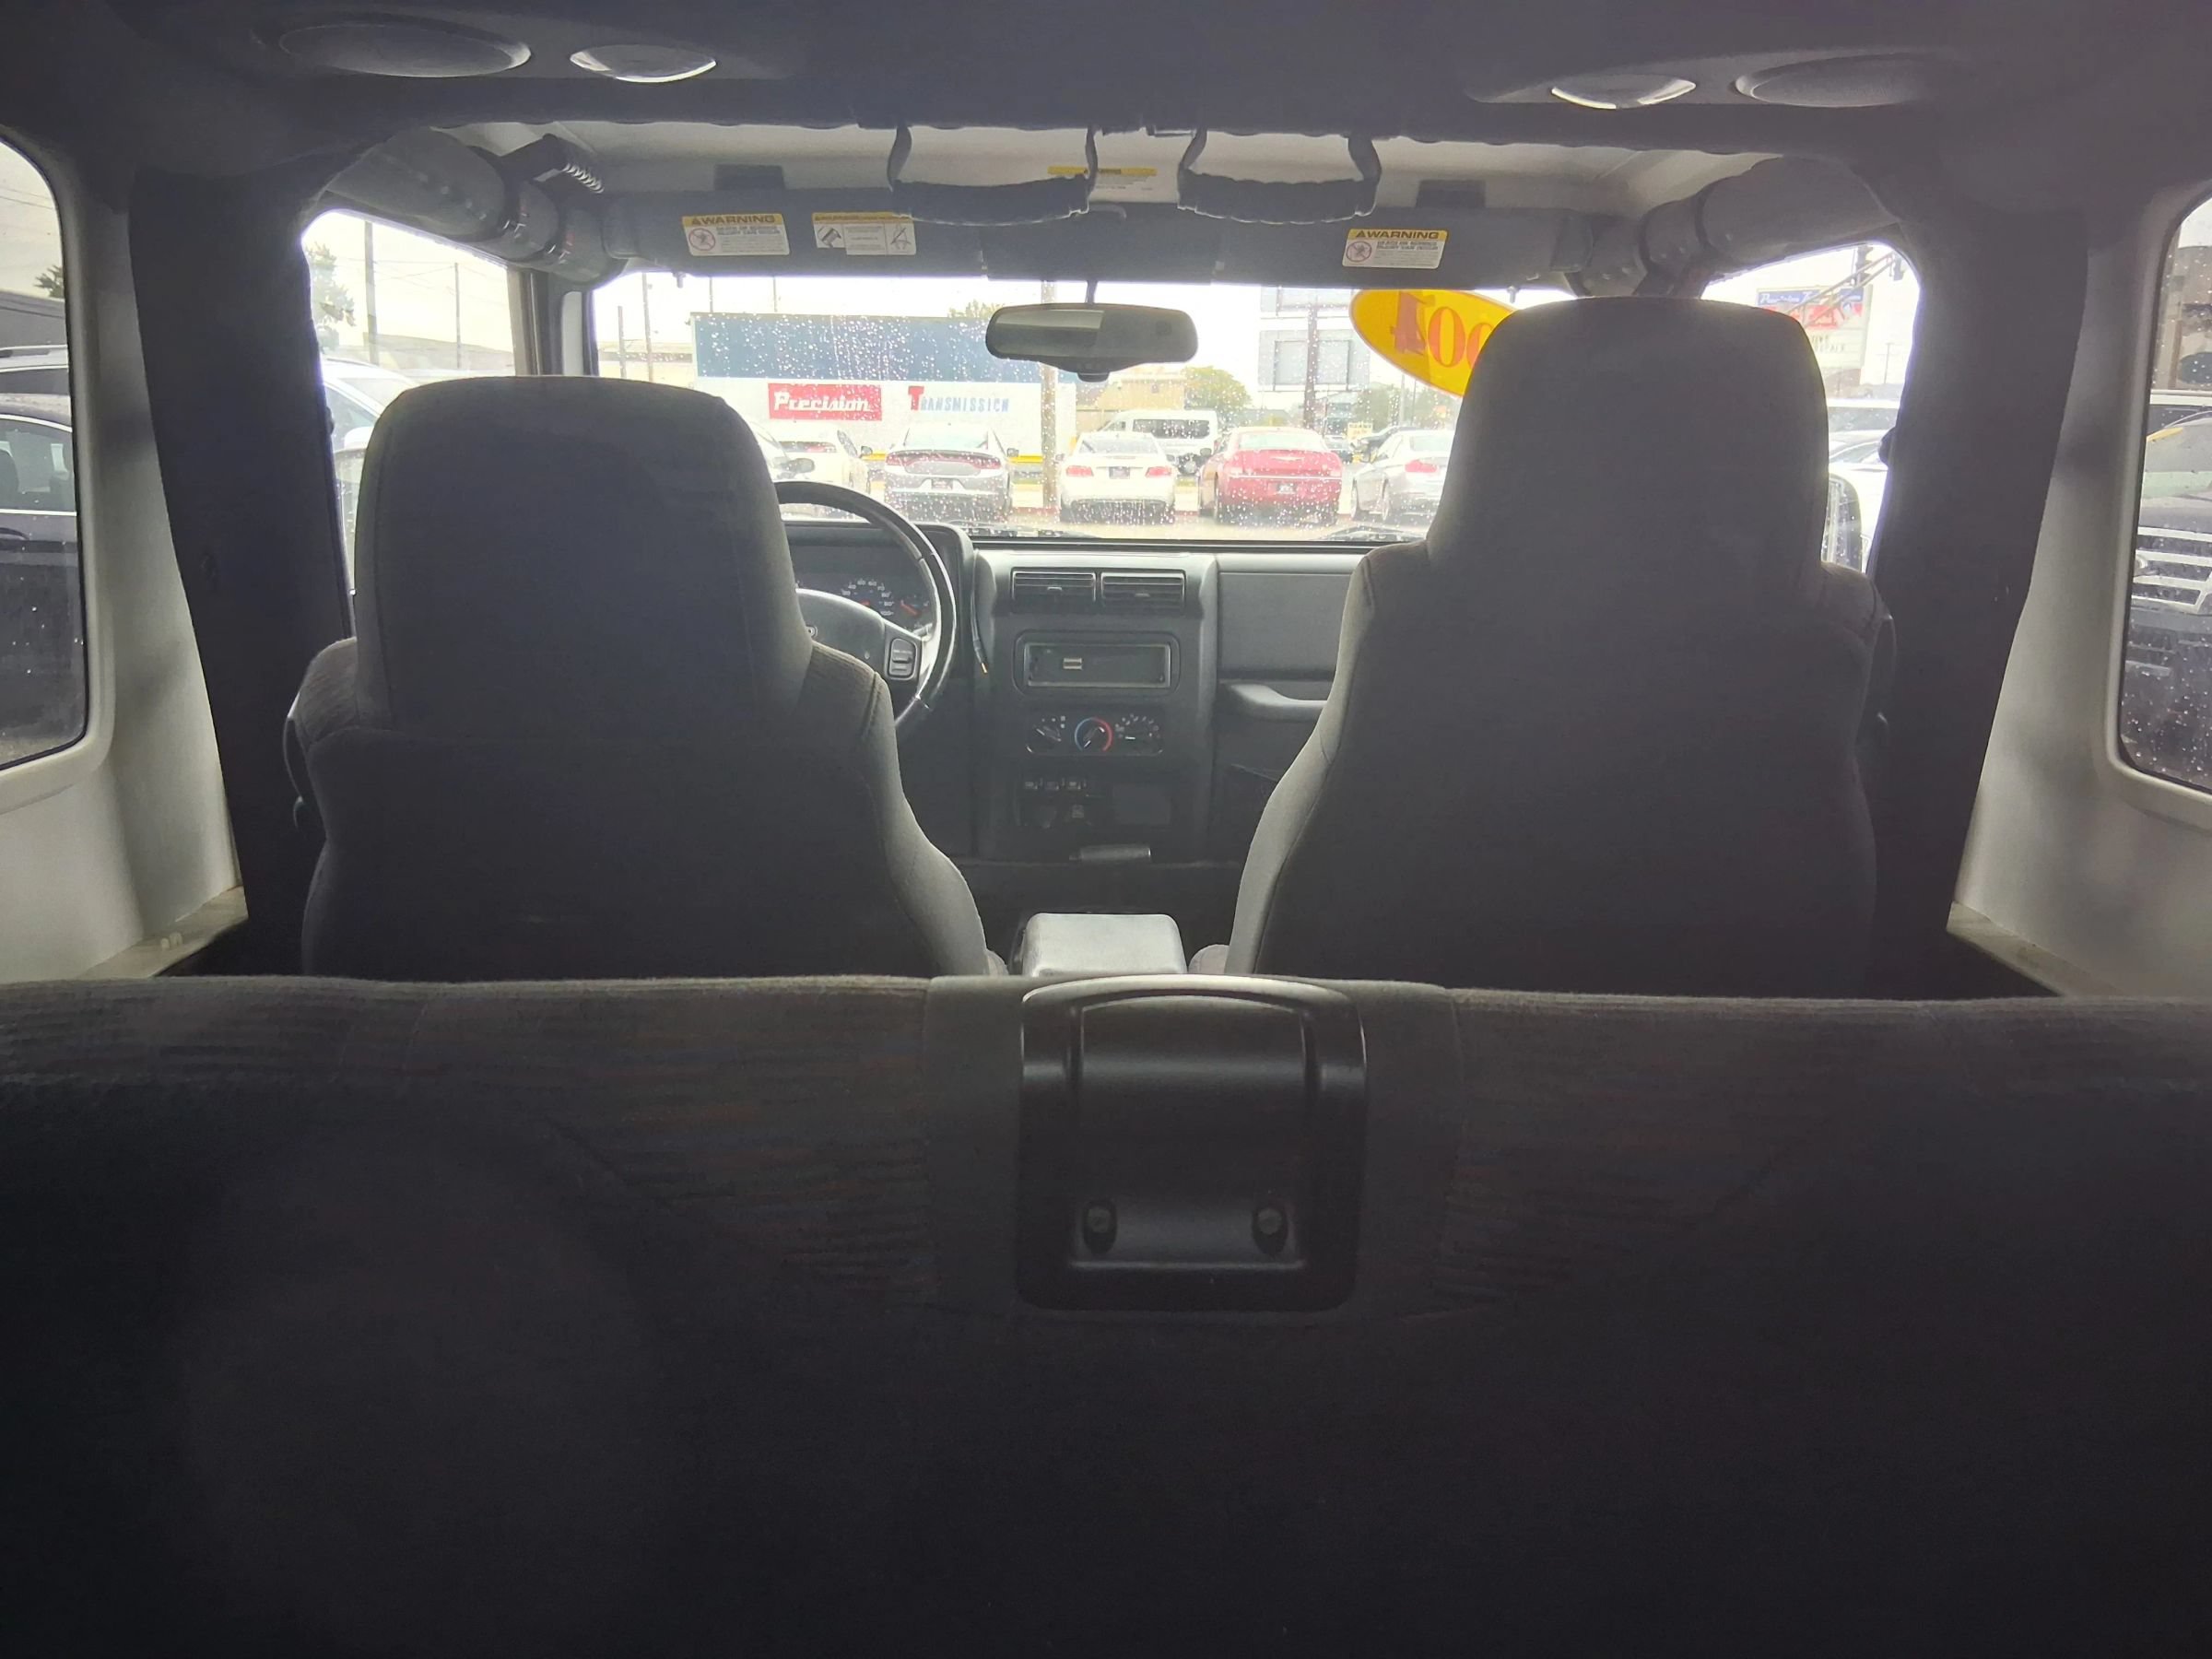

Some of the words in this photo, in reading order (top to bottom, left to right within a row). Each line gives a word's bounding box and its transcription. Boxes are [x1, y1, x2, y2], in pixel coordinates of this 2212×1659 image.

[701, 215, 775, 225] WARNING
[1368, 230, 1439, 240] WARNING
[772, 391, 871, 412] Precision
